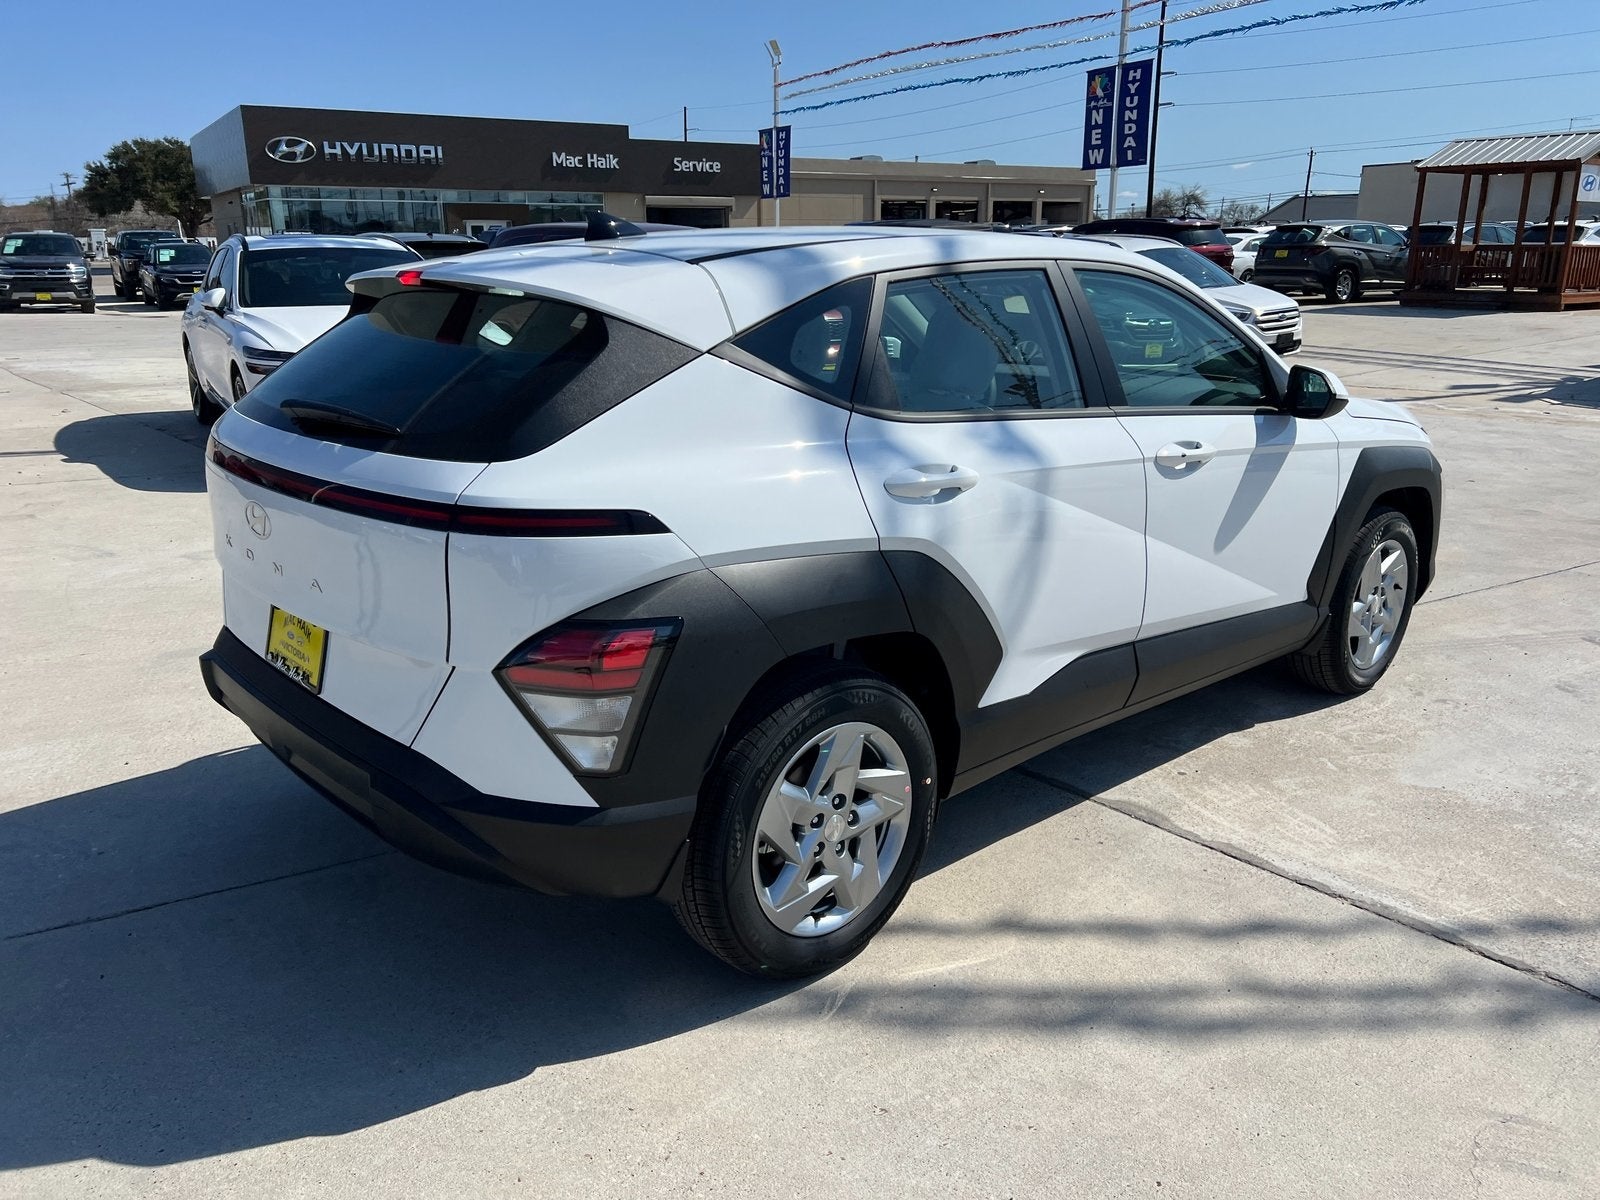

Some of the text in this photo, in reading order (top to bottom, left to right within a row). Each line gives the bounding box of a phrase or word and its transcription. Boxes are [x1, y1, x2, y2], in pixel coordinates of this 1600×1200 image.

[1088, 108, 1104, 165] NEW
[1123, 68, 1142, 161] HYUNDAI
[323, 141, 444, 165] HYUNDAI
[552, 151, 620, 169] Mac Haik
[673, 156, 721, 173] Service
[762, 157, 770, 195] NEW
[778, 131, 786, 193] HYUNDAI
[226, 533, 323, 593] KONA
